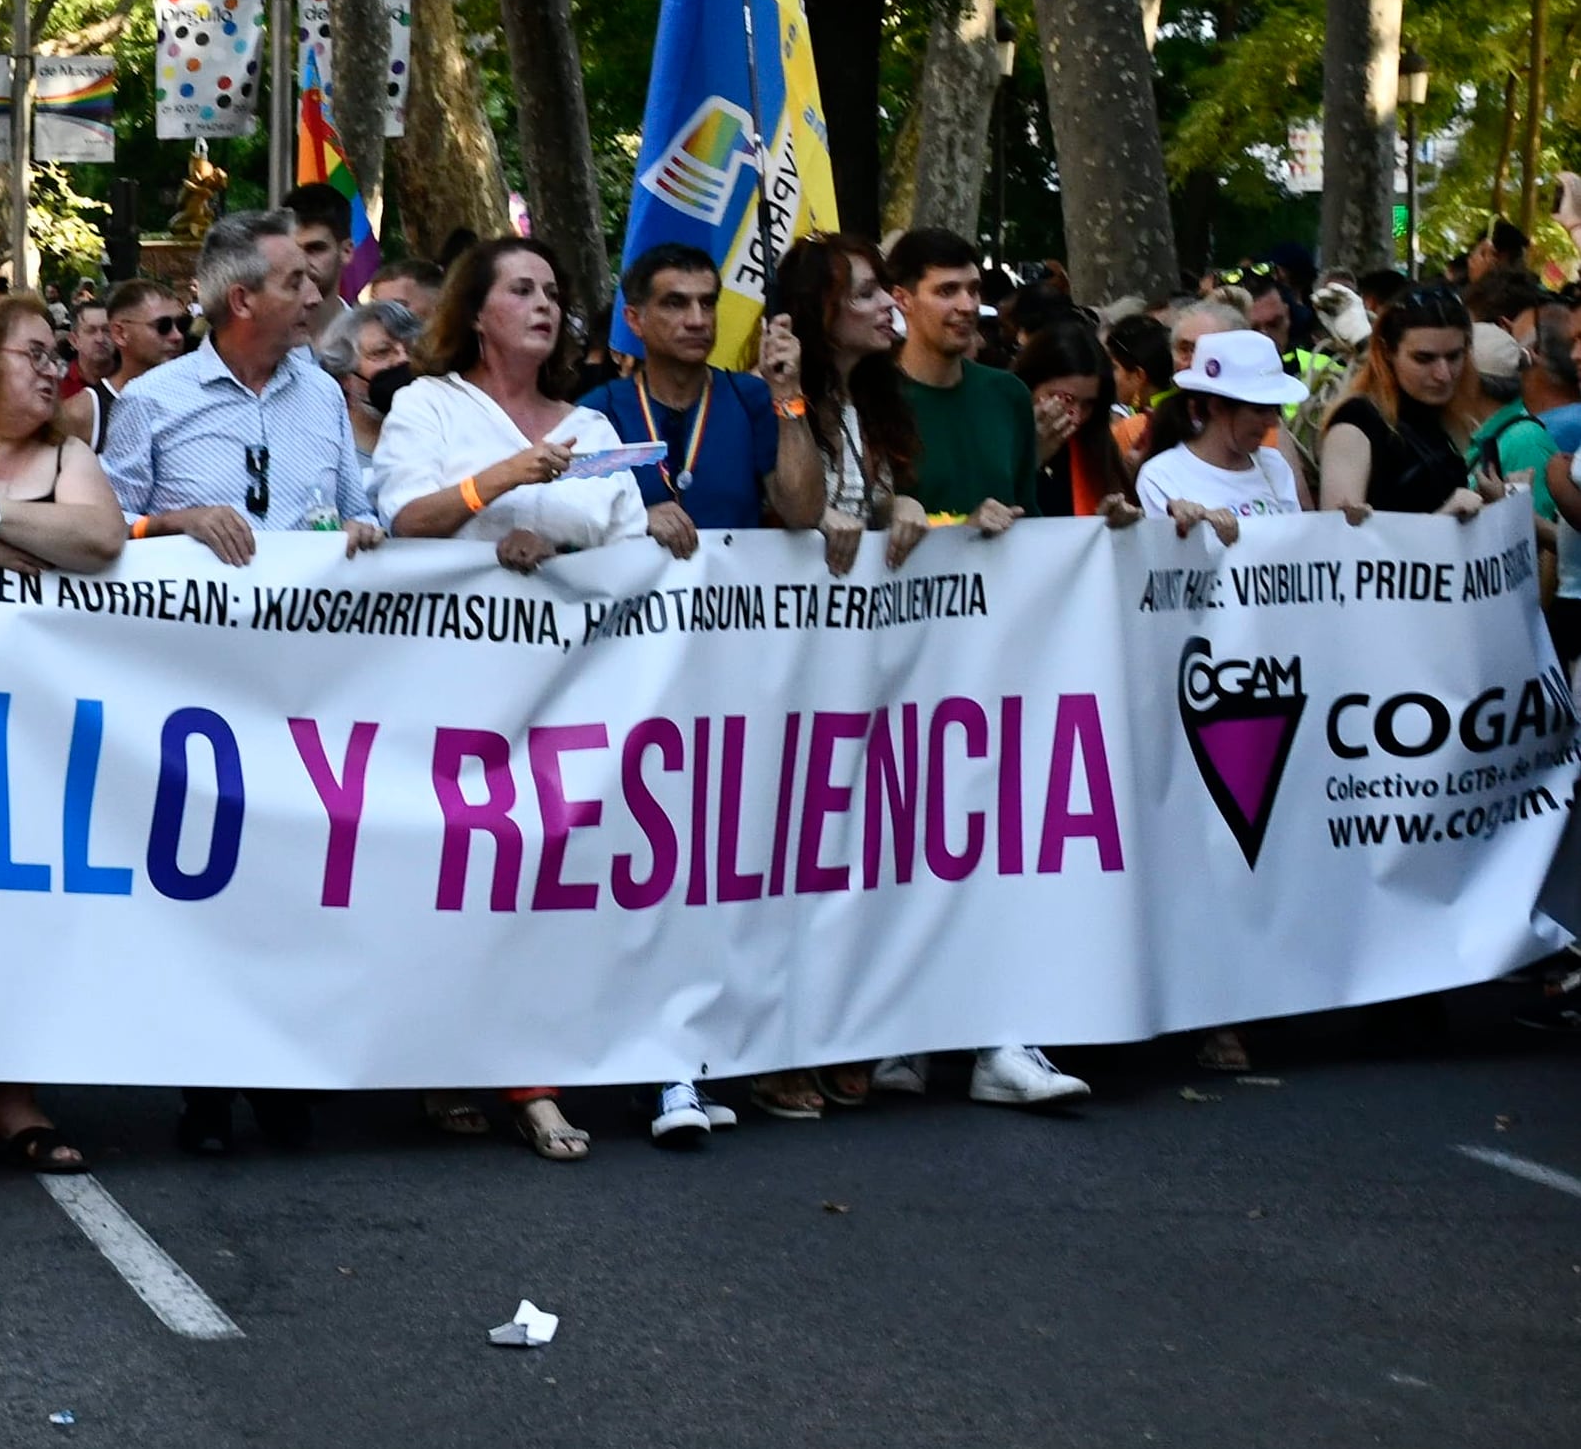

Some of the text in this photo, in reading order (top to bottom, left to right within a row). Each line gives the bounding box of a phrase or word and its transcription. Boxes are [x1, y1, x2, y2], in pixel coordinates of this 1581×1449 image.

[304, 3, 329, 21] de
[39, 65, 56, 77] de
[1231, 561, 1346, 607] VISIBILITY,
[1356, 560, 1454, 602] PRIDE
[1463, 555, 1502, 603] AND
[251, 586, 572, 653] IKUSGARRITASUNA,
[775, 584, 818, 628] ETA
[285, 715, 381, 908] Y
[431, 692, 1126, 913] RESILIENCIA
[1326, 772, 1440, 801] Colectivo
